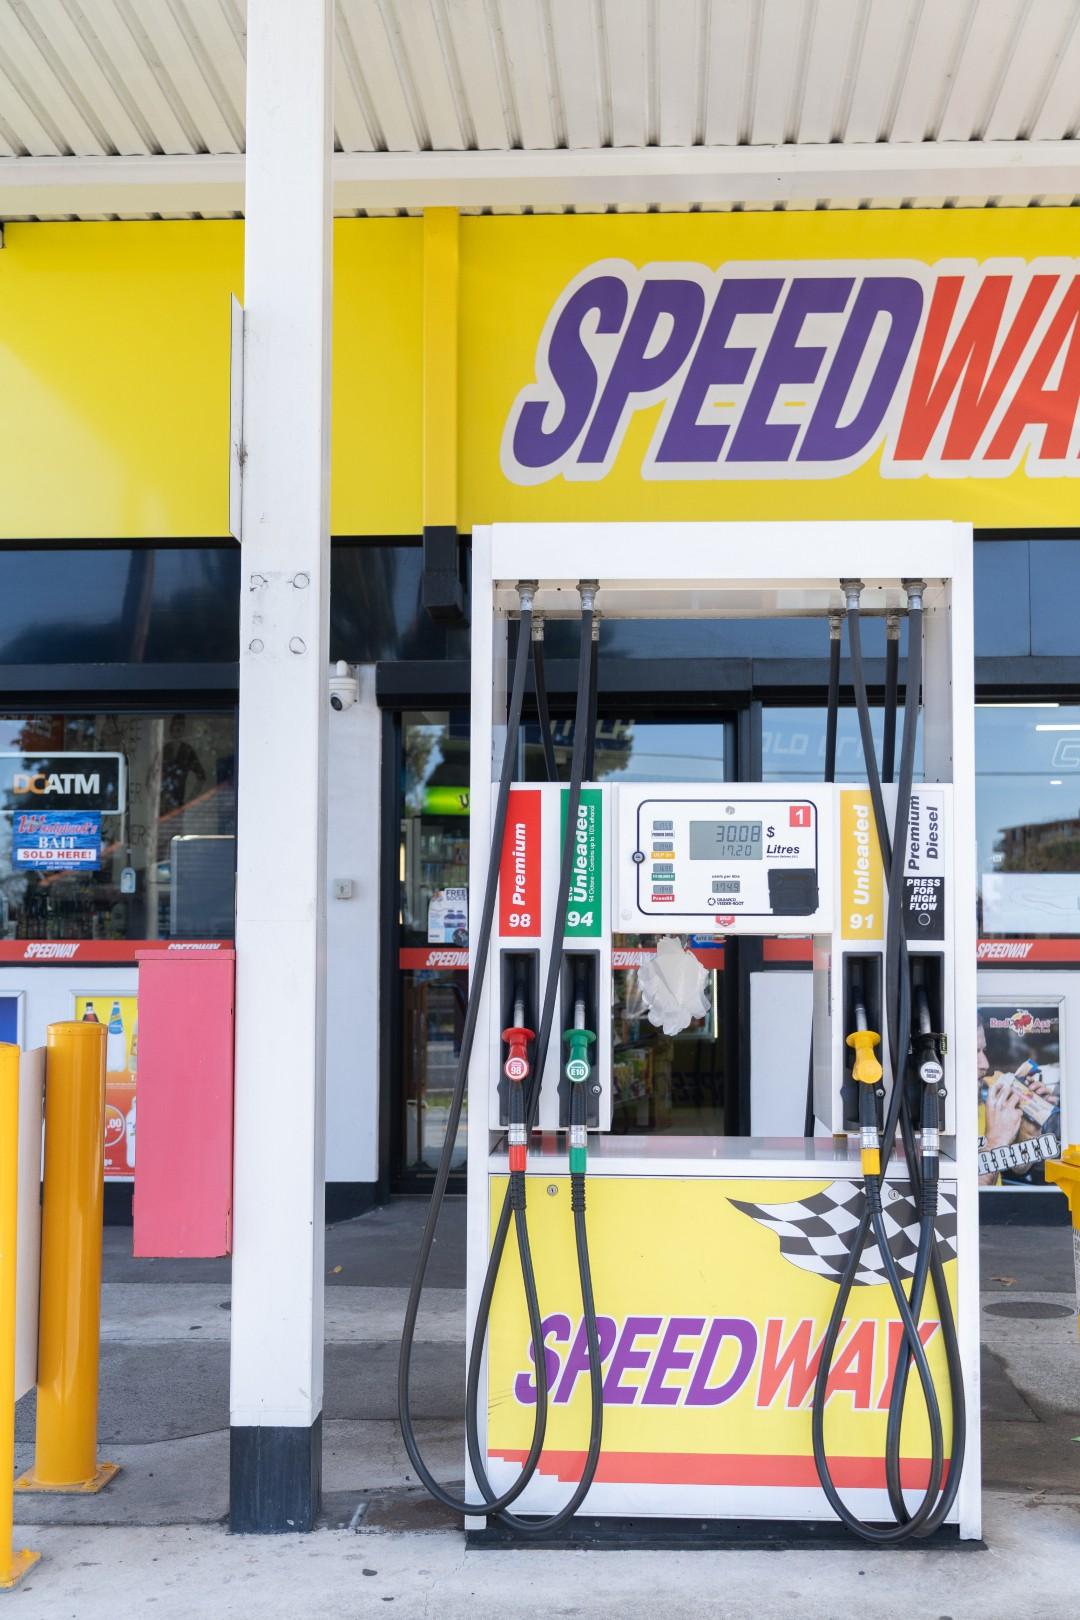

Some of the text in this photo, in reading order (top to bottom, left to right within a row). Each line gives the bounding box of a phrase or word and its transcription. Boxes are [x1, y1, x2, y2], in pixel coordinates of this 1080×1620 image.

[512, 274, 1080, 469] SPEEDWA
[795, 809, 805, 825] 1
[715, 825, 761, 843] 30.08
[766, 825, 775, 838] $
[908, 796, 920, 871] Premium
[926, 806, 939, 859] Diesel
[38, 836, 77, 849] BAIT
[766, 844, 800, 854] Litres
[23, 850, 92, 859] SOLD HERE!
[573, 804, 588, 903] Unleaded
[853, 805, 870, 905] Unleaded
[512, 823, 526, 906] Premium
[906, 878, 941, 887] PRESS
[910, 895, 937, 903] HIGH
[909, 903, 938, 911] FLOW
[508, 913, 531, 927] 98
[567, 911, 594, 926] 94
[849, 914, 875, 929] 91
[24, 943, 80, 958] SPEEDWAY
[977, 943, 1033, 958] SPEEDWAY
[510, 1066, 521, 1075] 98
[571, 1068, 584, 1076] E10
[977, 1133, 1059, 1176] RRITO
[514, 1313, 940, 1410] SPEEDWAY
